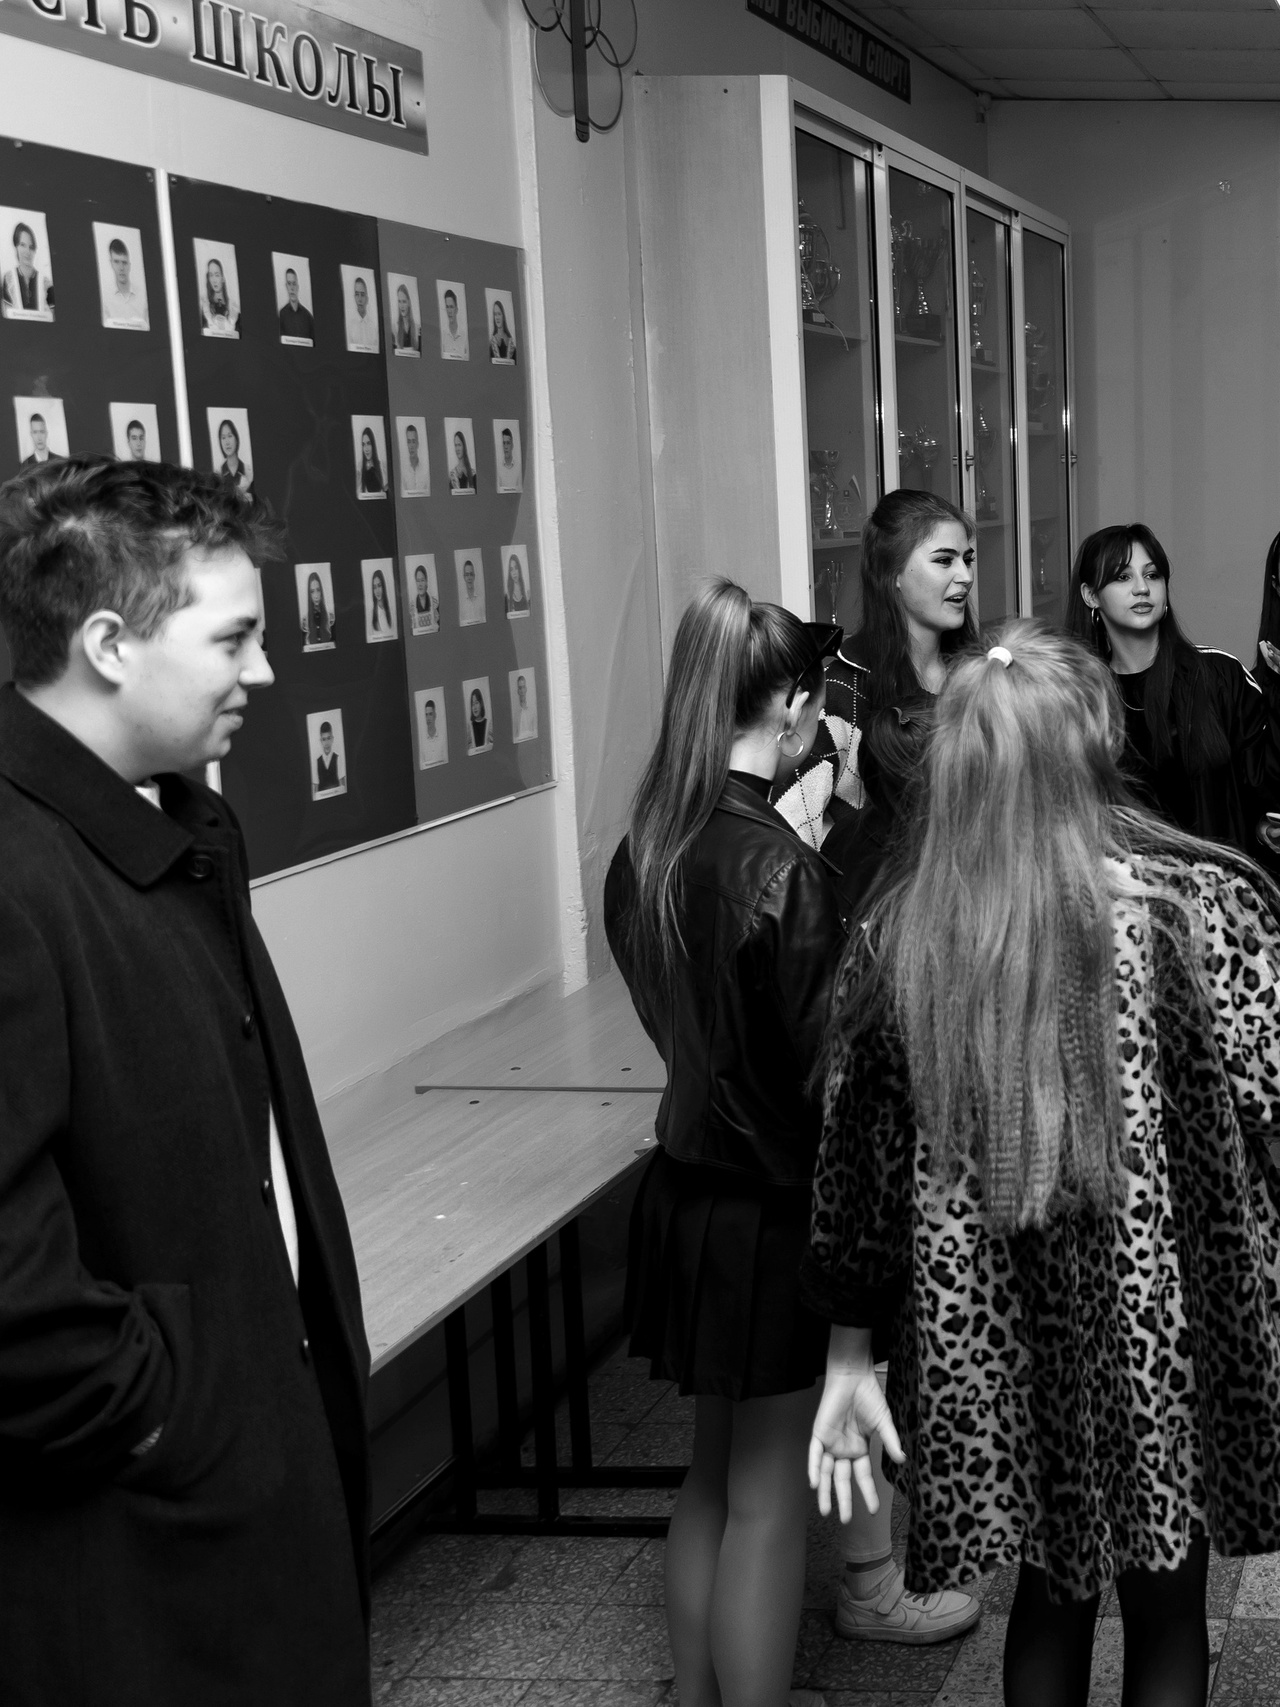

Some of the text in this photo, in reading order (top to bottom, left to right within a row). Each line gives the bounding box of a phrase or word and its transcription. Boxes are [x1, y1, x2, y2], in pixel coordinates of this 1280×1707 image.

[191, 0, 406, 127] ШКОЛЫ
[786, 0, 909, 94] ВЫБИРАЕМ СПОРТ!
